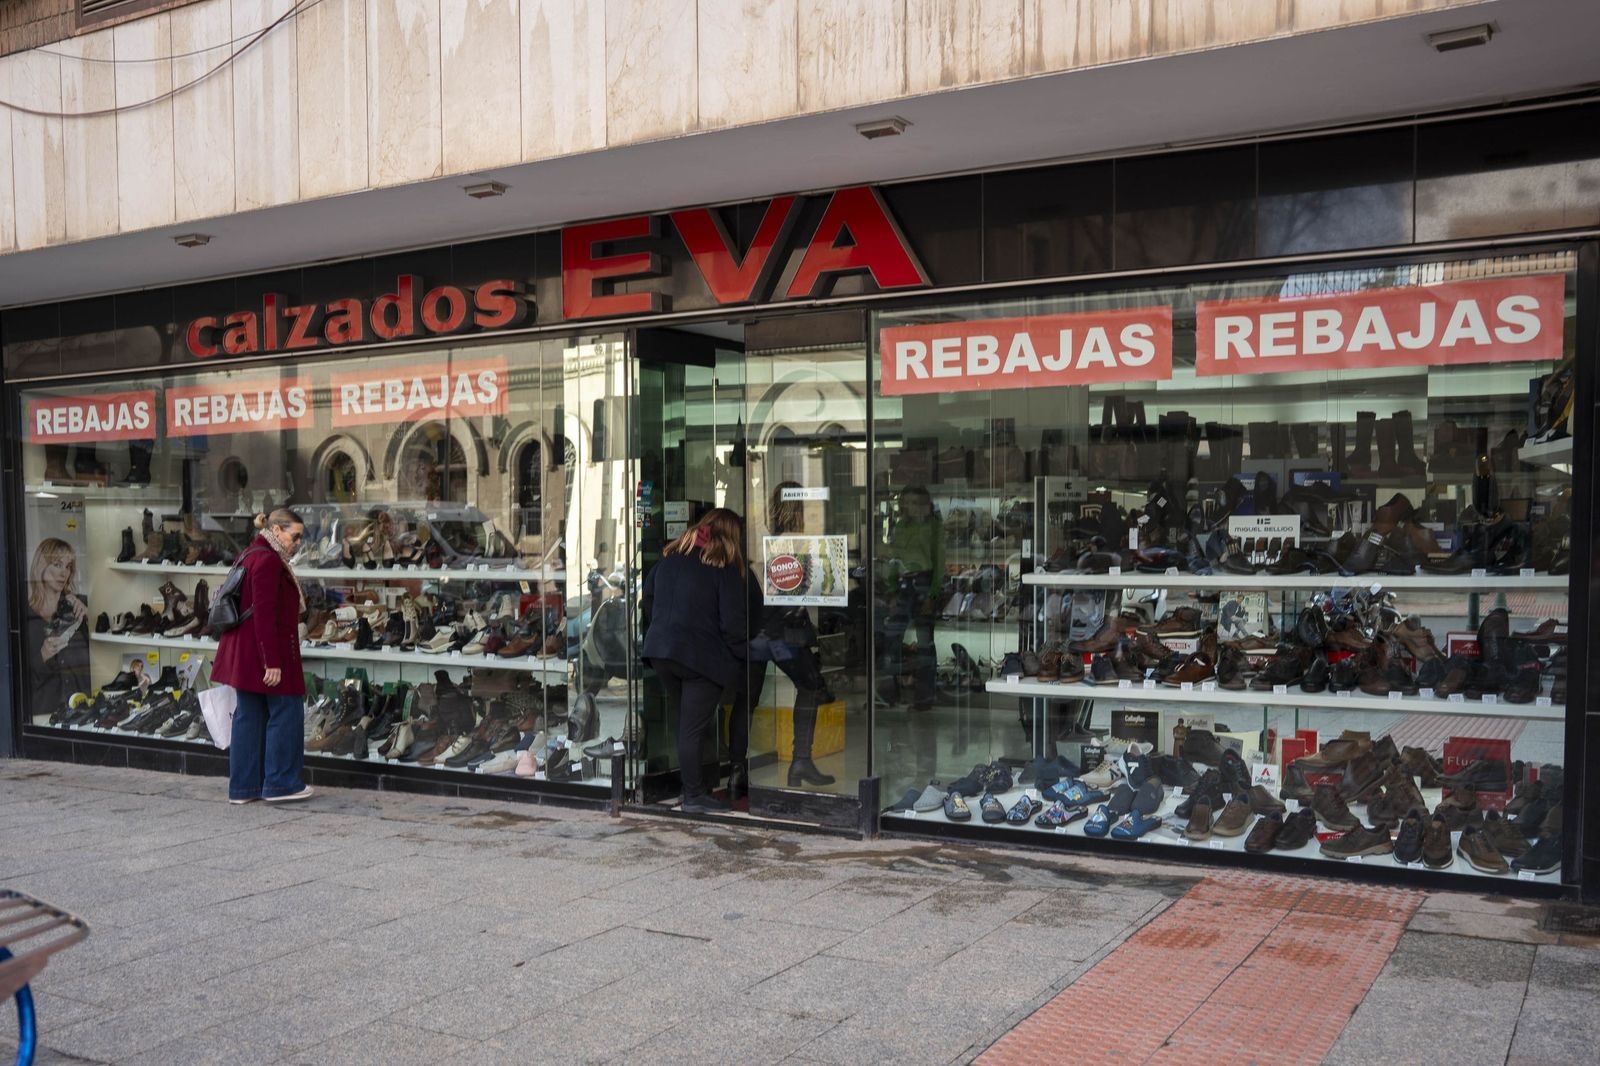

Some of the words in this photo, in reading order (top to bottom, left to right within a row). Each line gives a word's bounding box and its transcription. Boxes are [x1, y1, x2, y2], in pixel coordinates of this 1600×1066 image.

[187, 274, 520, 358] calzados
[561, 186, 924, 319] EVA
[1213, 295, 1541, 360] REBAJAS
[895, 322, 1156, 381] REBAJAS
[173, 387, 307, 427] REBAJAS
[341, 370, 499, 416] REBAJAS
[36, 401, 150, 435] REBAJAS
[771, 562, 799, 573] BONOS
